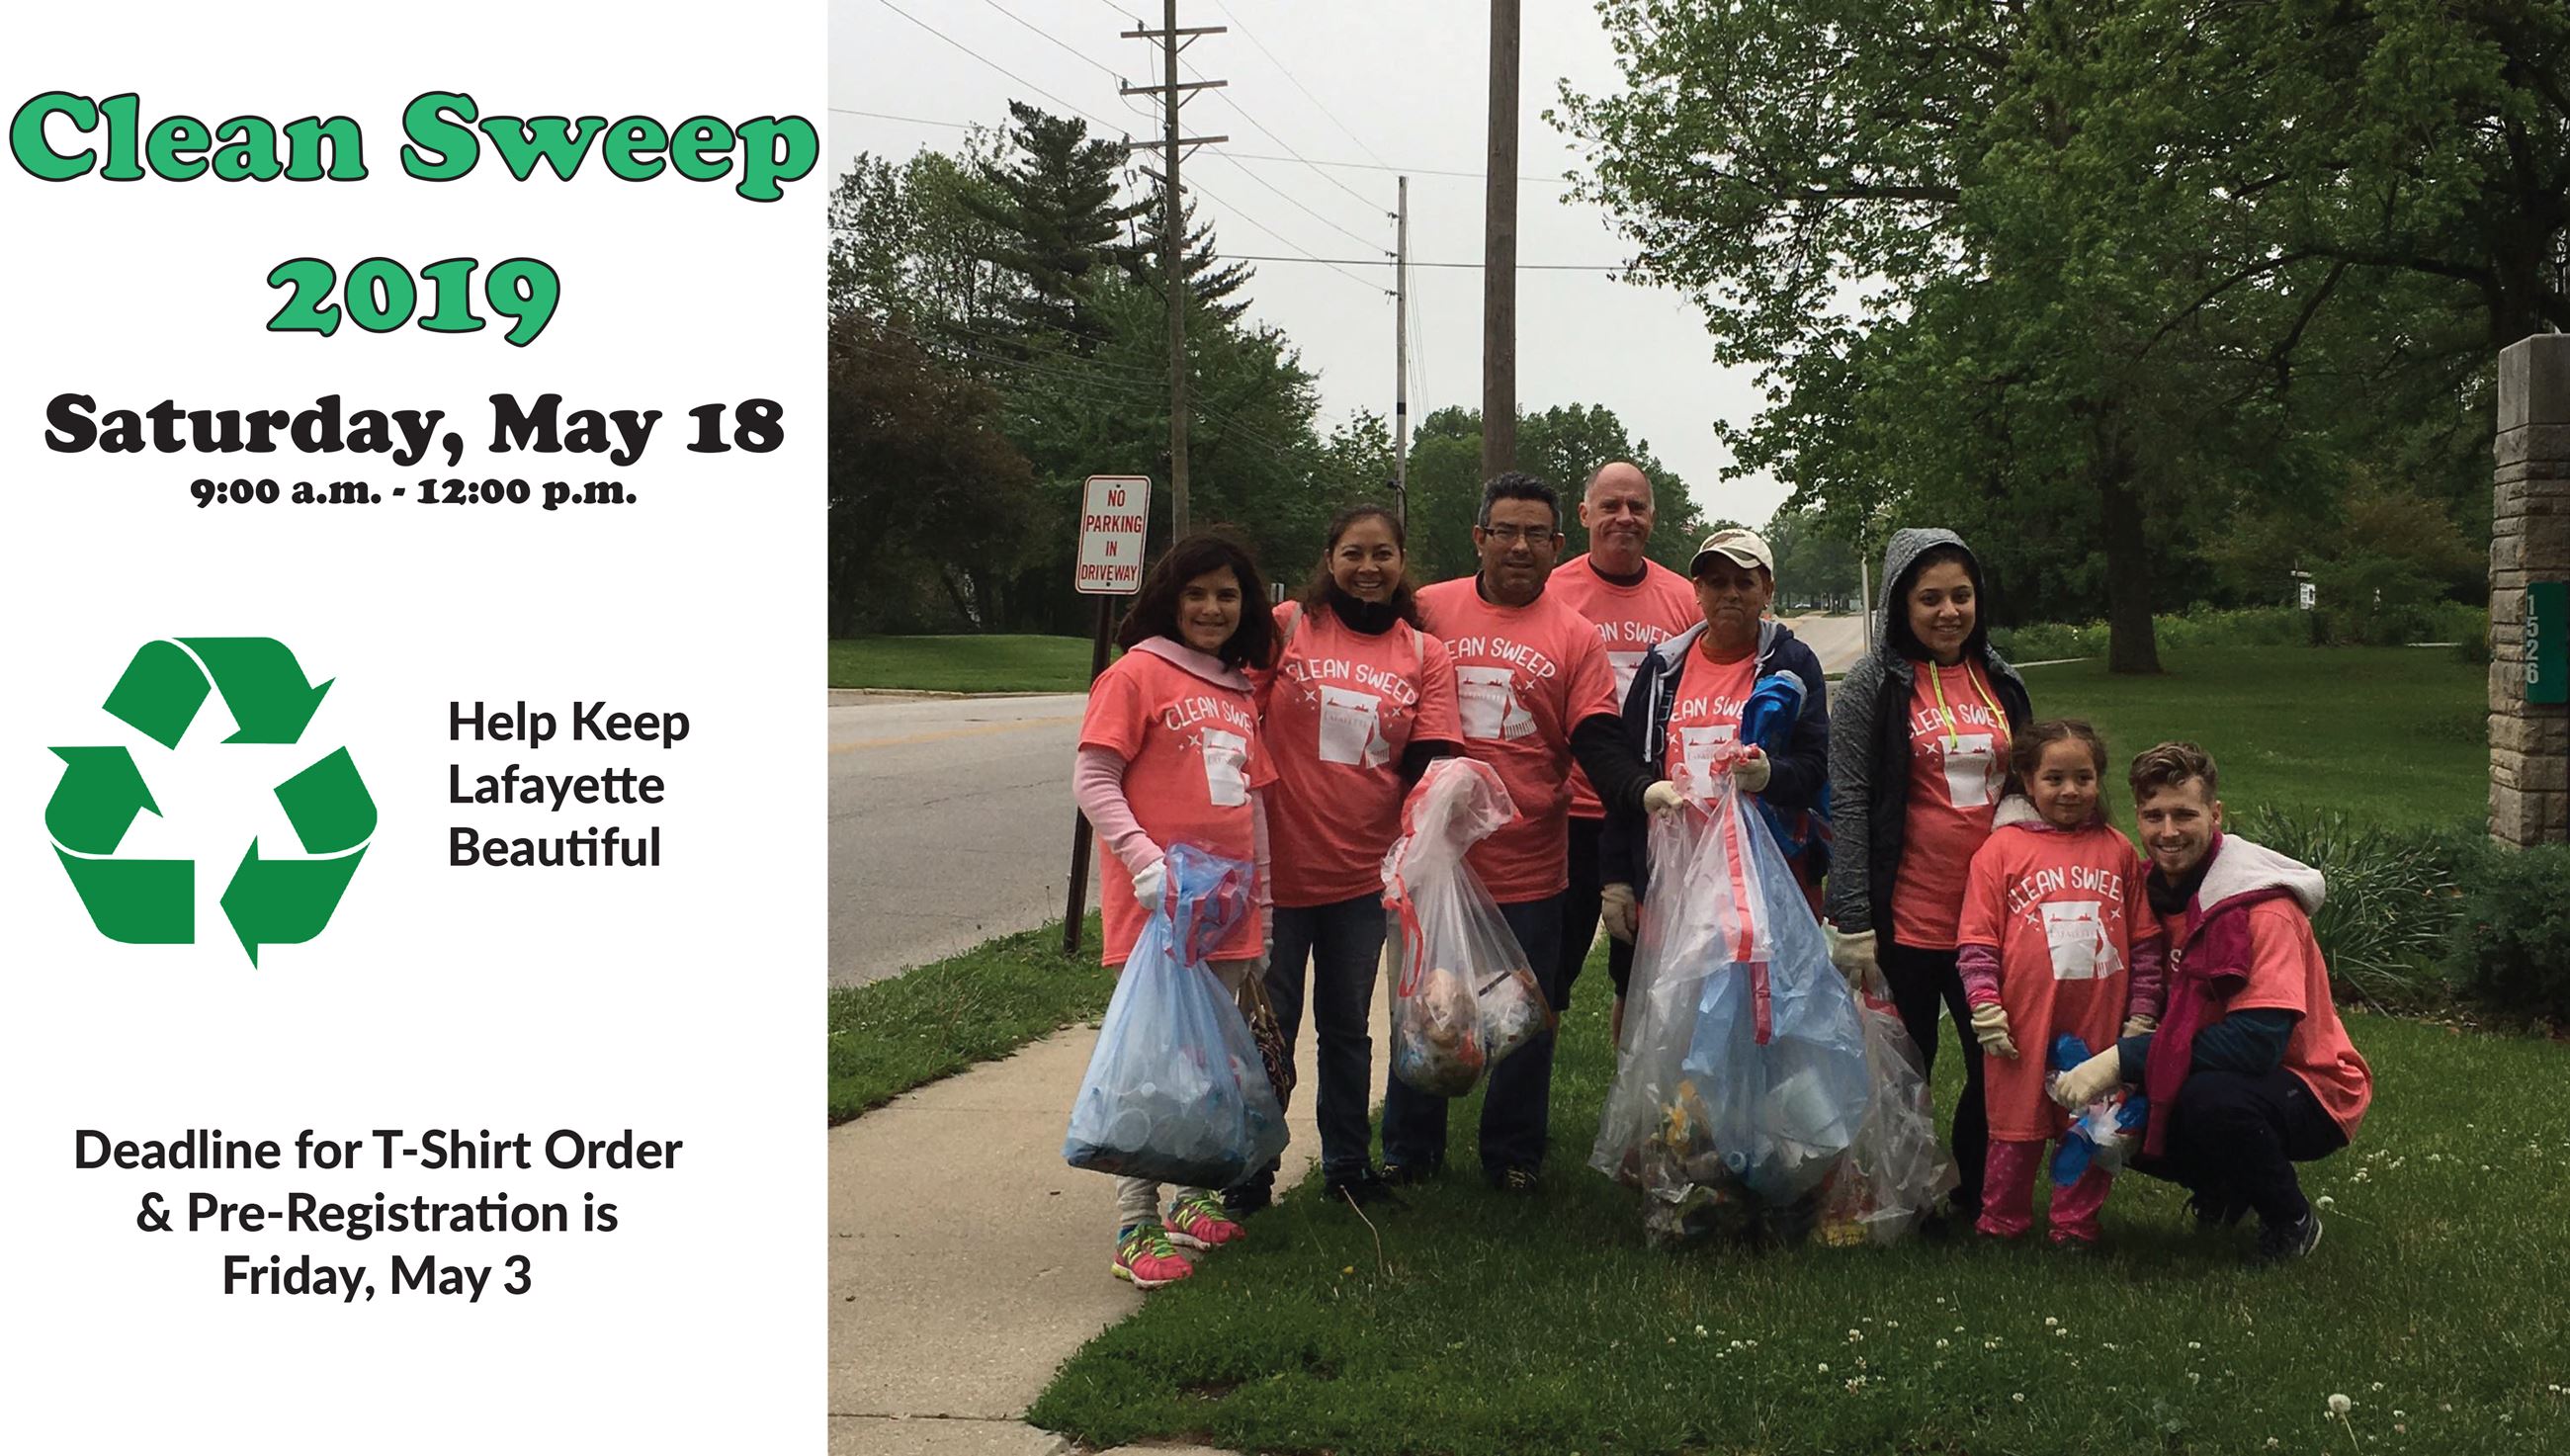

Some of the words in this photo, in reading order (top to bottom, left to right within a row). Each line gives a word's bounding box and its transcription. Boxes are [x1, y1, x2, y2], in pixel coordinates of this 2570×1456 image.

[1107, 489, 1125, 507] NO
[1085, 515, 1143, 533] PARKING
[1105, 541, 1118, 557] IN
[1080, 564, 1137, 581] DRIVEWAY
[1491, 638, 1556, 678] SWEEP
[2527, 595, 2538, 684] 1526
[1286, 659, 1350, 683] CLEAN
[1355, 664, 1416, 705] SWEEP
[1166, 696, 1220, 730] CLEAN
[1221, 700, 1253, 734] SWE
[2008, 867, 2065, 914] CLEAN
[2071, 865, 2124, 903] SWEE
